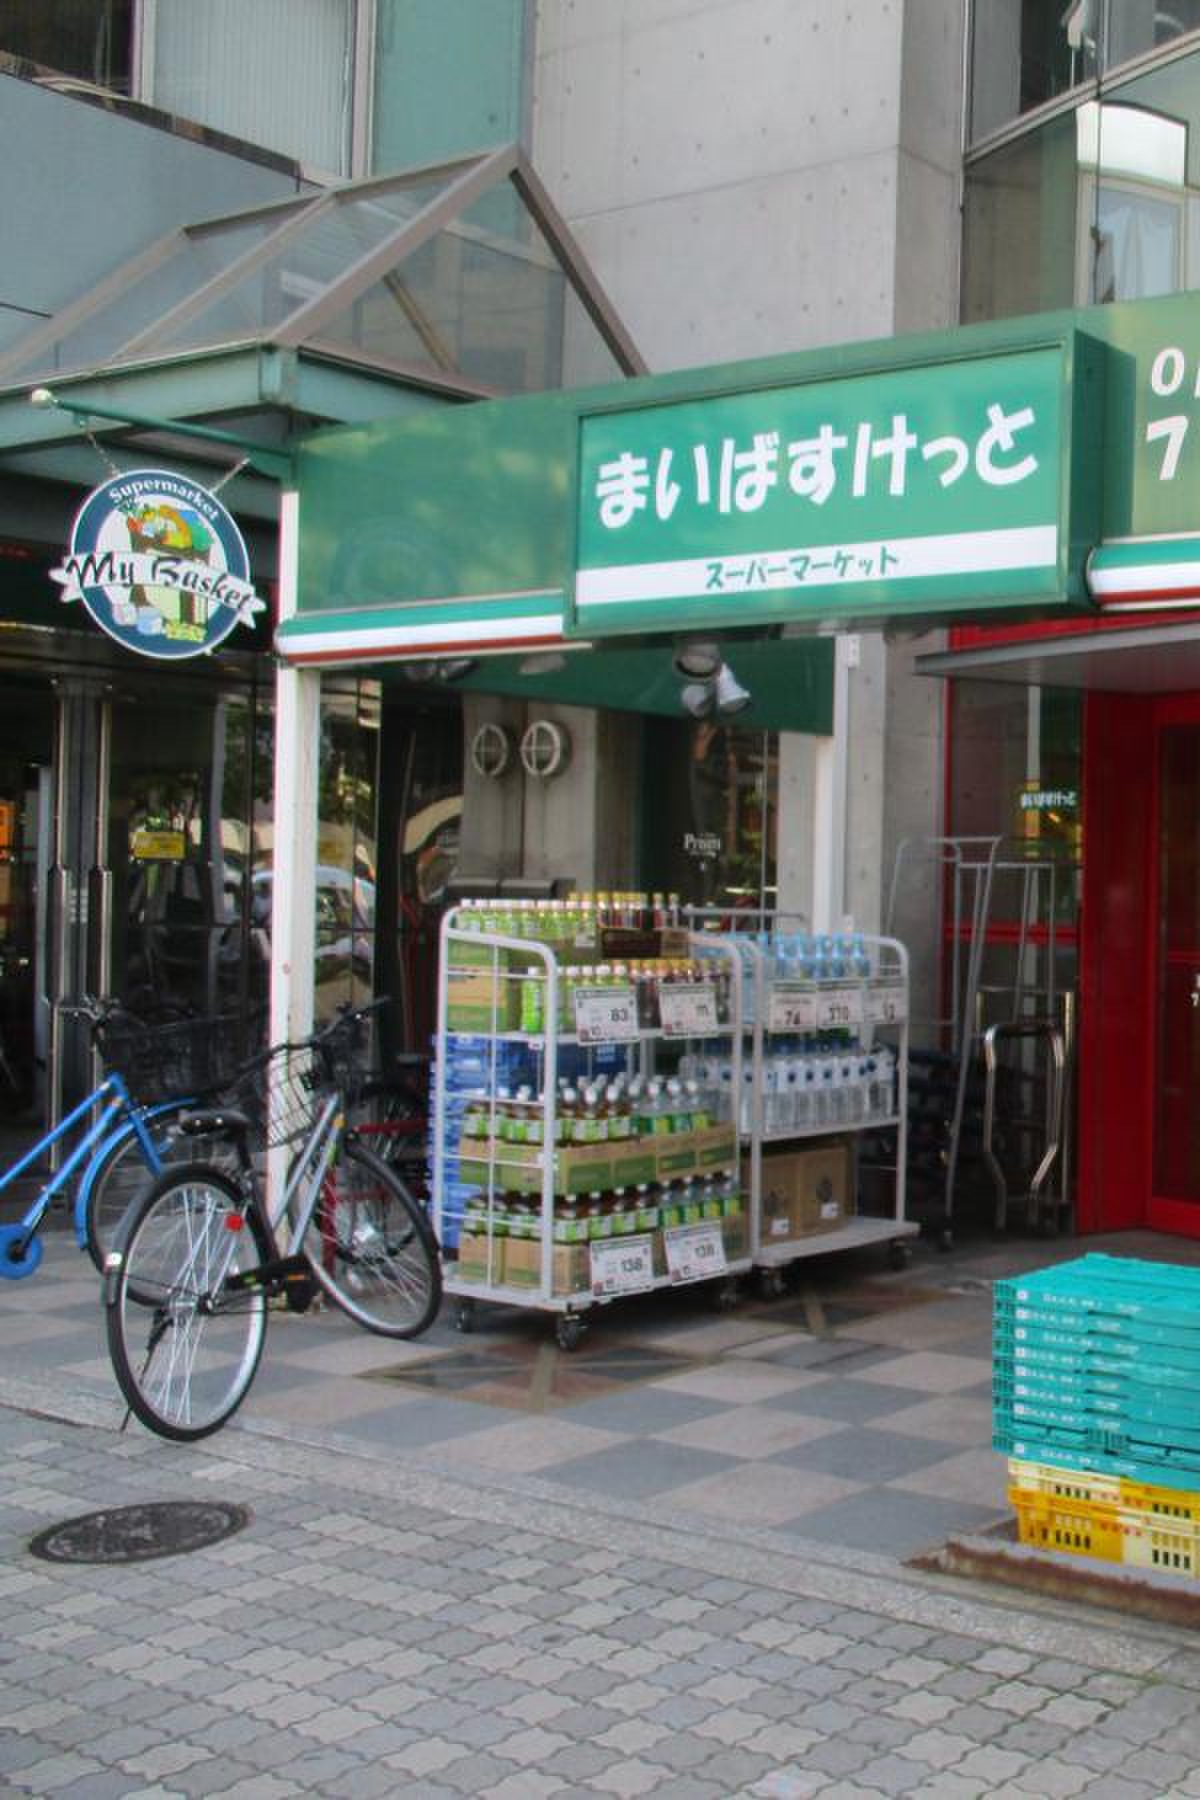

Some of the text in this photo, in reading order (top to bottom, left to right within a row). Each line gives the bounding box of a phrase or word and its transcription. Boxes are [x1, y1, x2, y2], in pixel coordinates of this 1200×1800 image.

[595, 403, 1039, 529] まいばすけっと
[108, 478, 219, 521] Supermarket
[65, 551, 134, 588] My
[704, 545, 900, 591] スーパーマーケット
